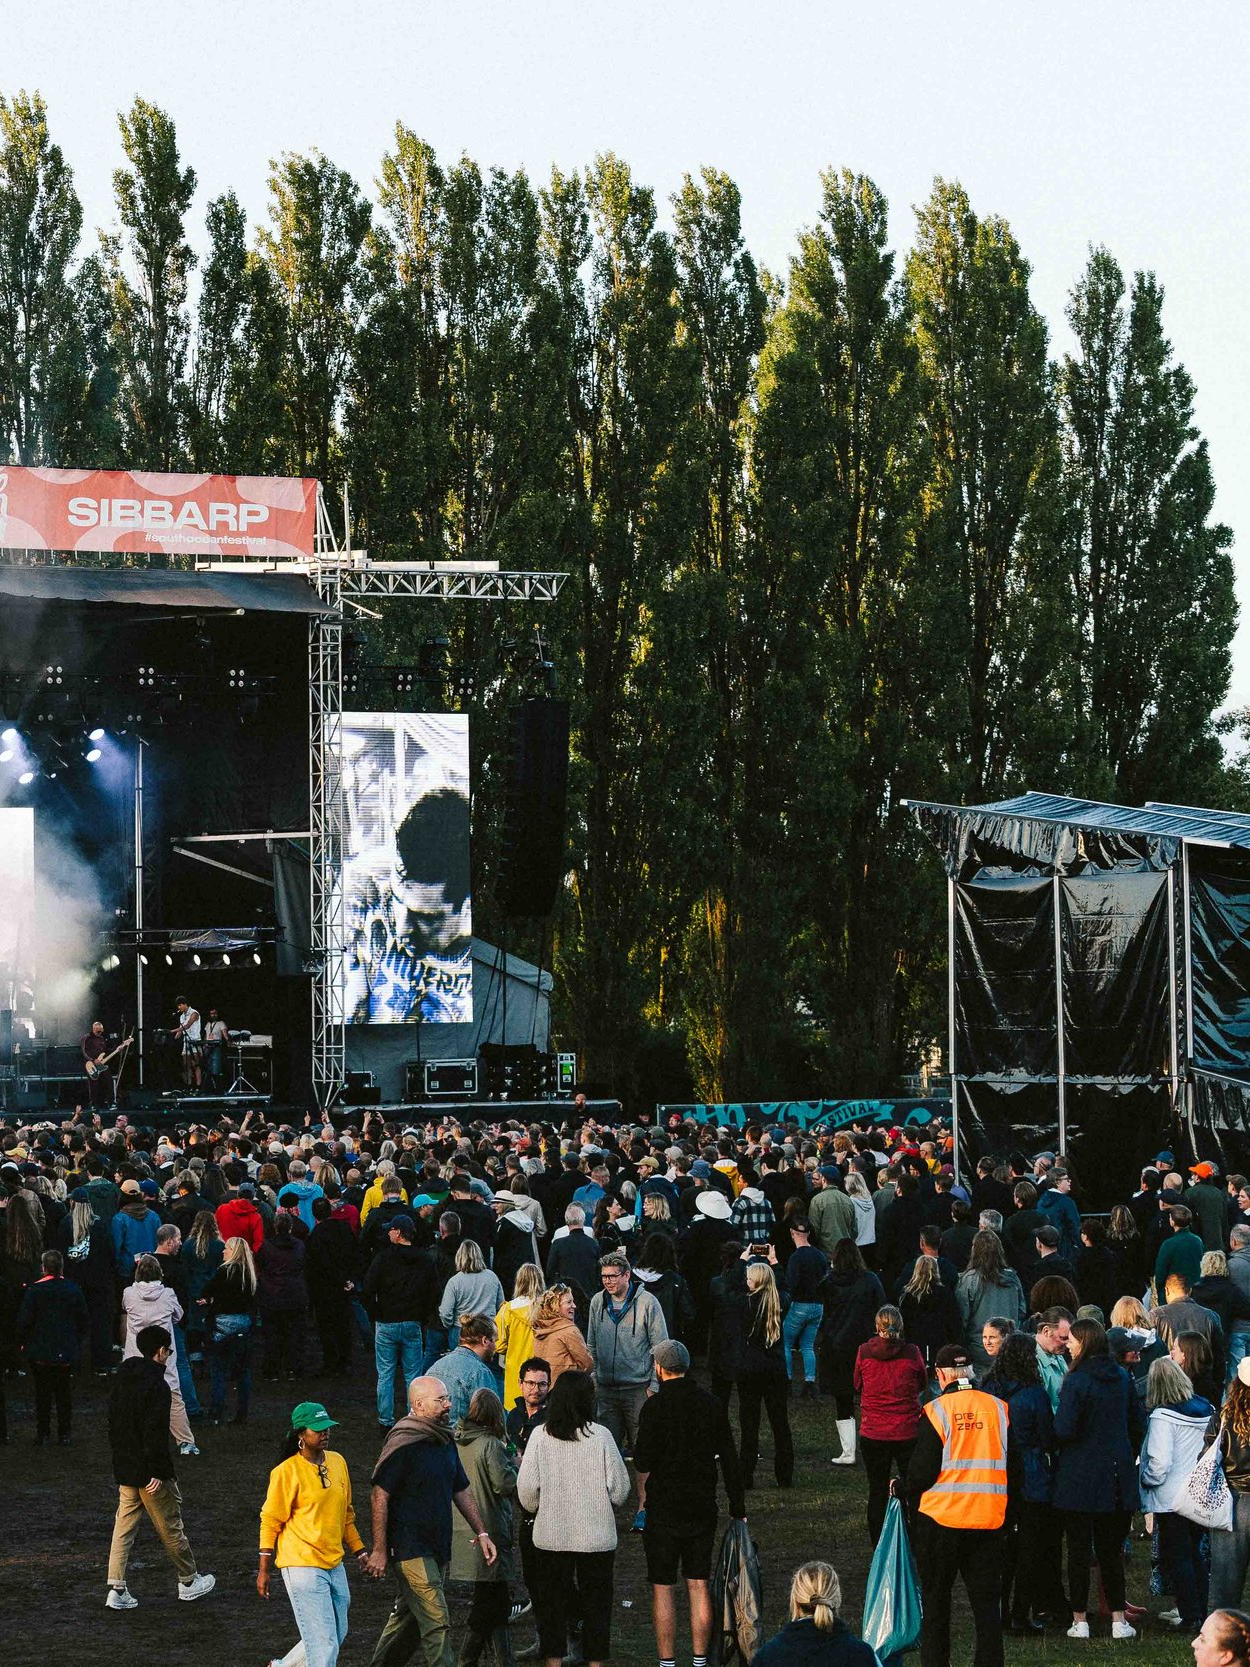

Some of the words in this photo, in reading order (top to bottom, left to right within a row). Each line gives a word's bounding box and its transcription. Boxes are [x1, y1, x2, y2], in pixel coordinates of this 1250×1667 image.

[67, 497, 270, 532] SIBBARP
[145, 532, 267, 546] #southoceanfestival
[954, 1412, 975, 1423] pre
[956, 1421, 984, 1431] zero
